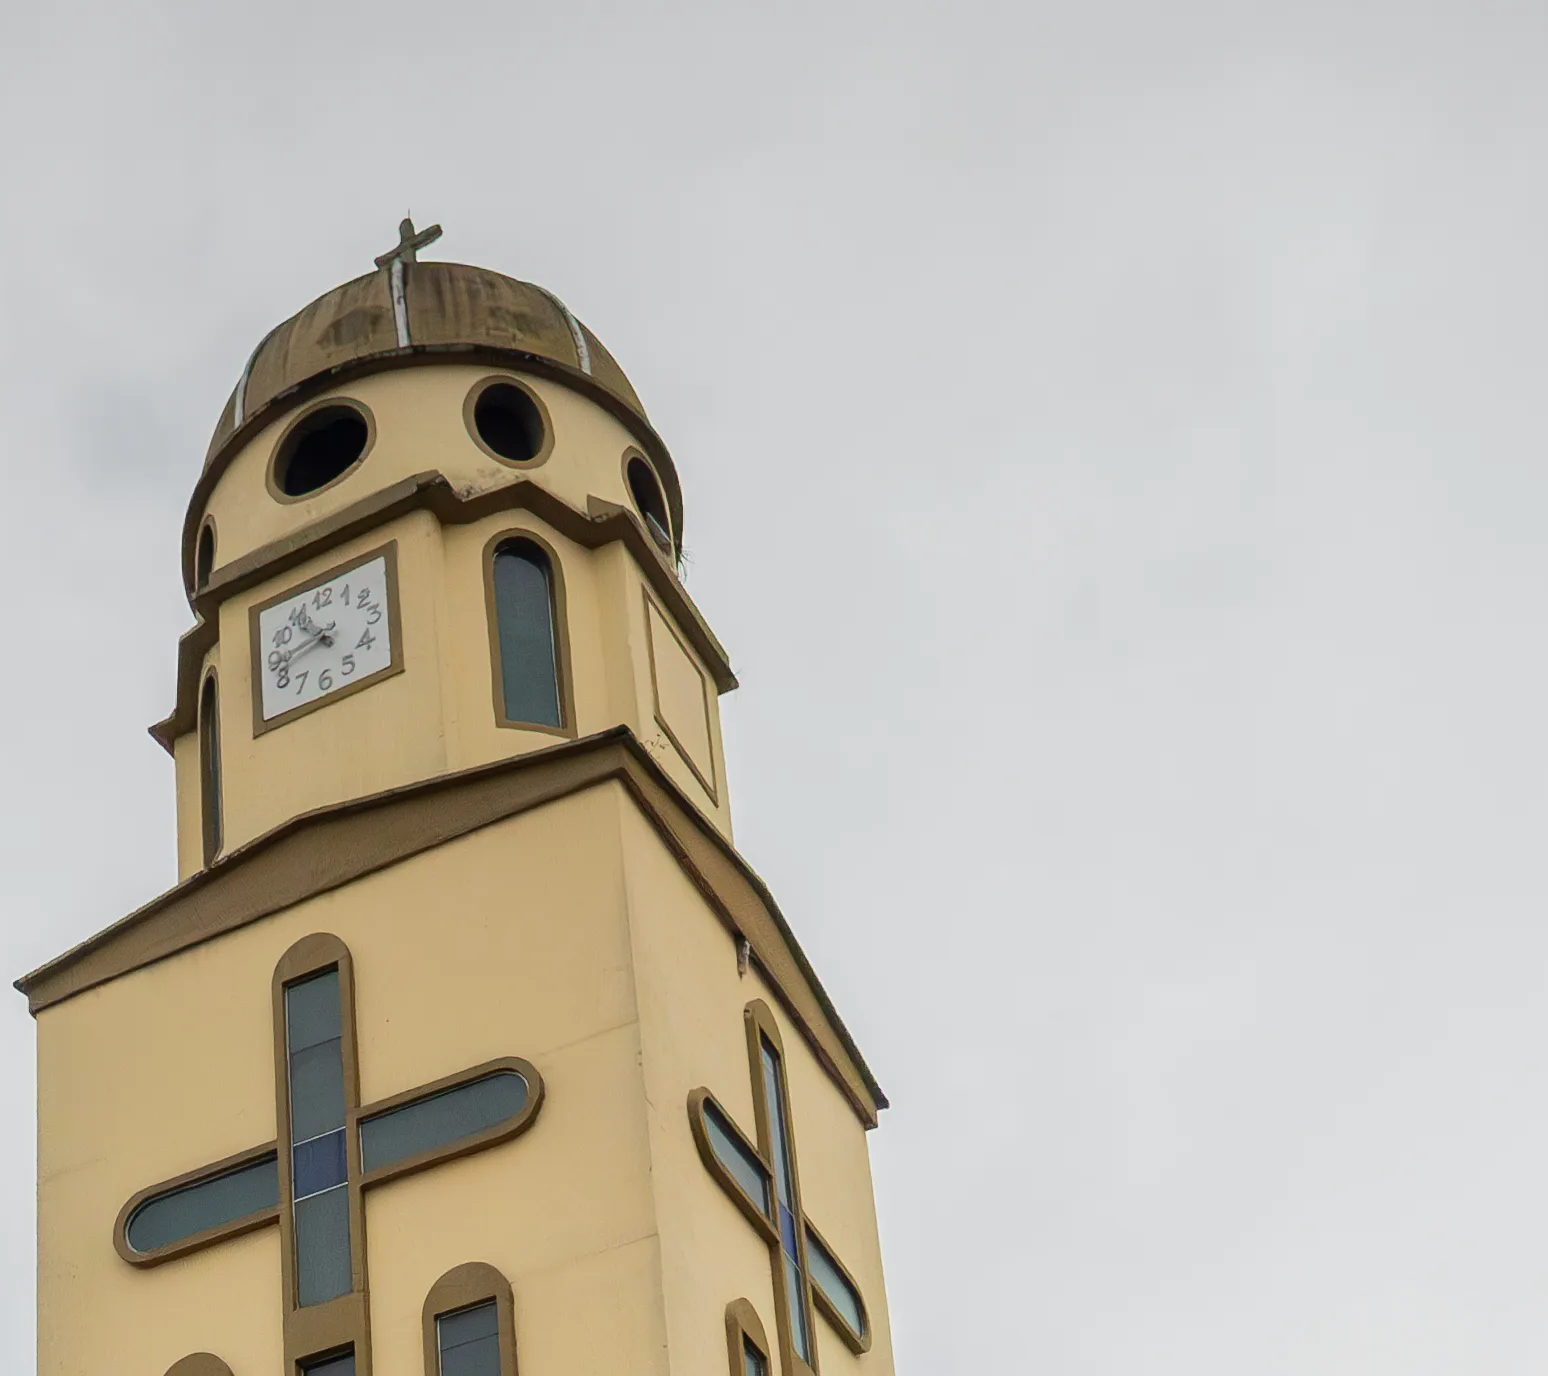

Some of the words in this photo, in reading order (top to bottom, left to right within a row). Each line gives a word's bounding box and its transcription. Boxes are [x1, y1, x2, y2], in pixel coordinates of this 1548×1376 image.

[312, 587, 333, 611] 12
[340, 584, 350, 606] 1
[357, 587, 371, 609] 2
[366, 603, 382, 625] 3
[354, 627, 376, 650] 4
[267, 650, 283, 672] 9
[341, 654, 355, 676] 5
[276, 667, 291, 689] 8
[295, 670, 310, 695] 7
[318, 669, 333, 690] 6
